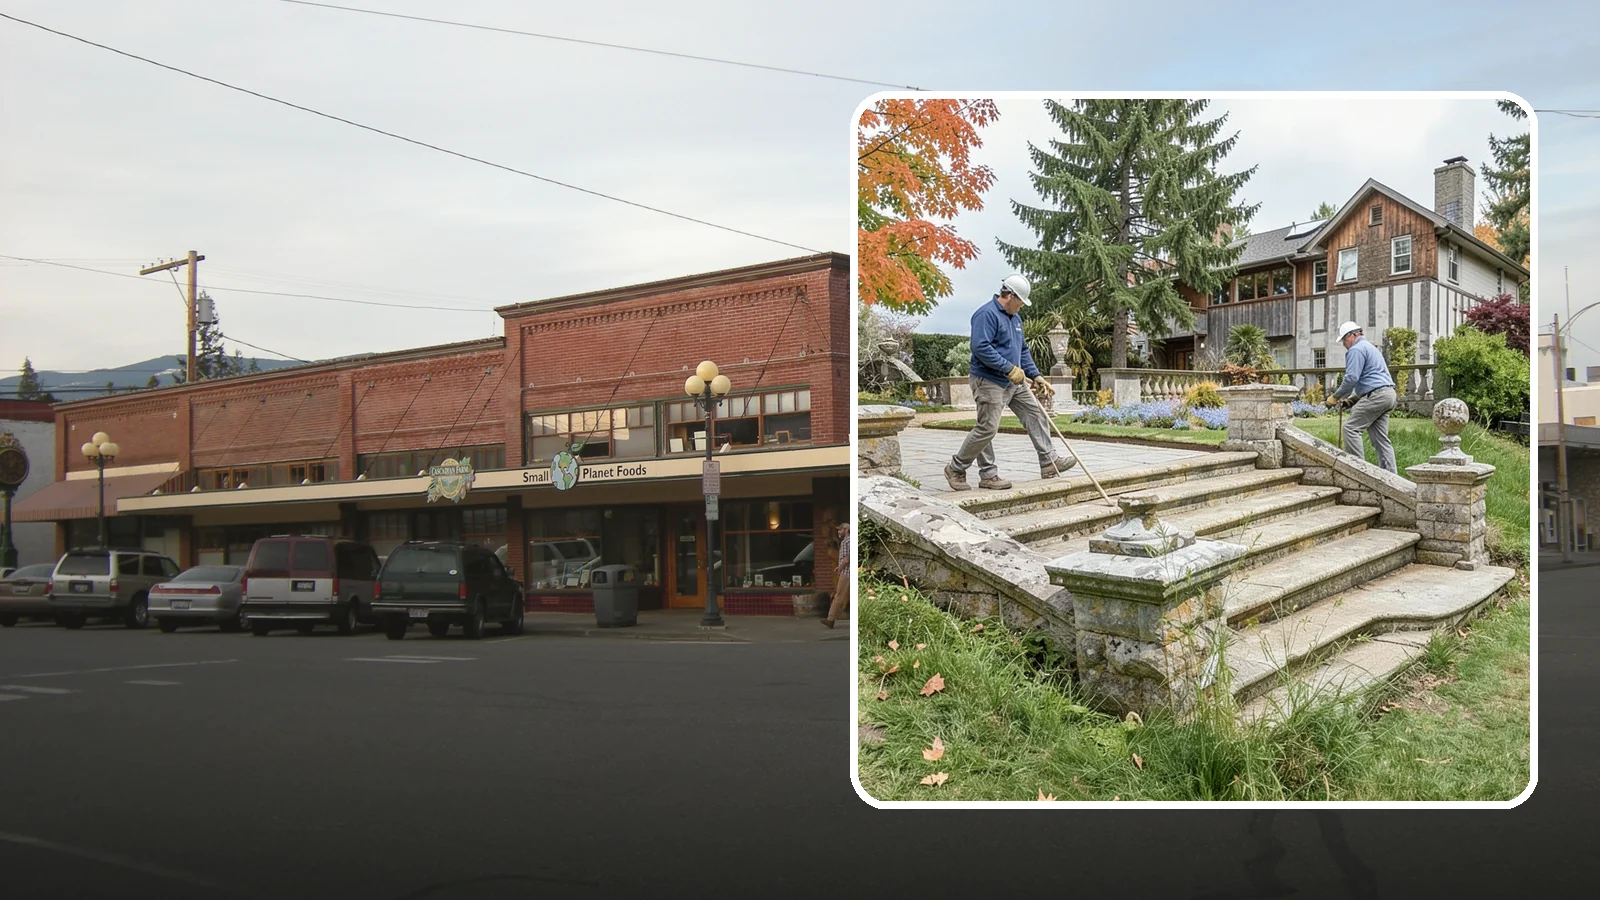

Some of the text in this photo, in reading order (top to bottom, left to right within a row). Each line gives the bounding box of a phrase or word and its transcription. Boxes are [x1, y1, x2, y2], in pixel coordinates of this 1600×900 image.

[523, 464, 647, 483] Small Planet Foods
